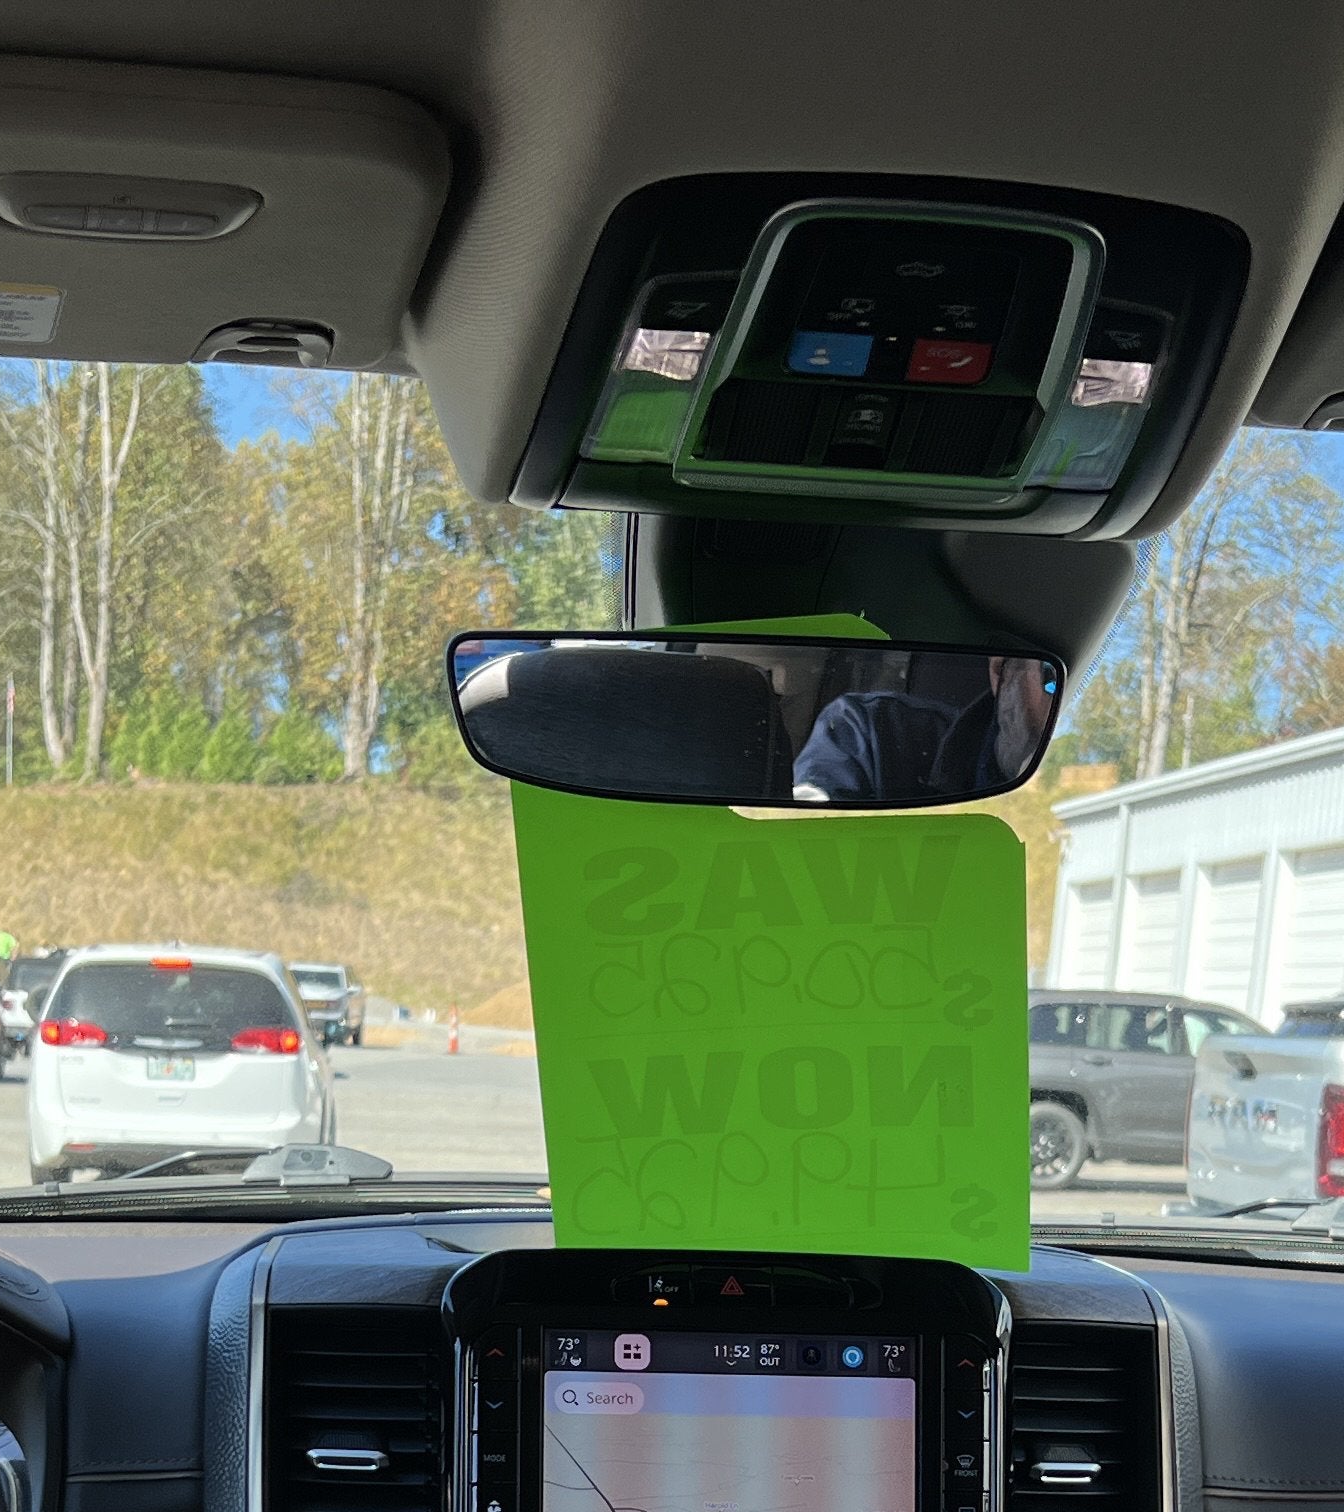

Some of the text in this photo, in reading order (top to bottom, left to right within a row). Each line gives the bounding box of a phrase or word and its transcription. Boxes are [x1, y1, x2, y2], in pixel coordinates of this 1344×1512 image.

[557, 1337, 580, 1351] 73°
[760, 1344, 780, 1355] 87°
[713, 1345, 751, 1358] 11:52
[883, 1344, 906, 1358] 73°
[759, 1357, 781, 1367] OUT
[586, 1391, 634, 1405] Search
[483, 1454, 506, 1463] MODE
[955, 1469, 979, 1477] FRONT
